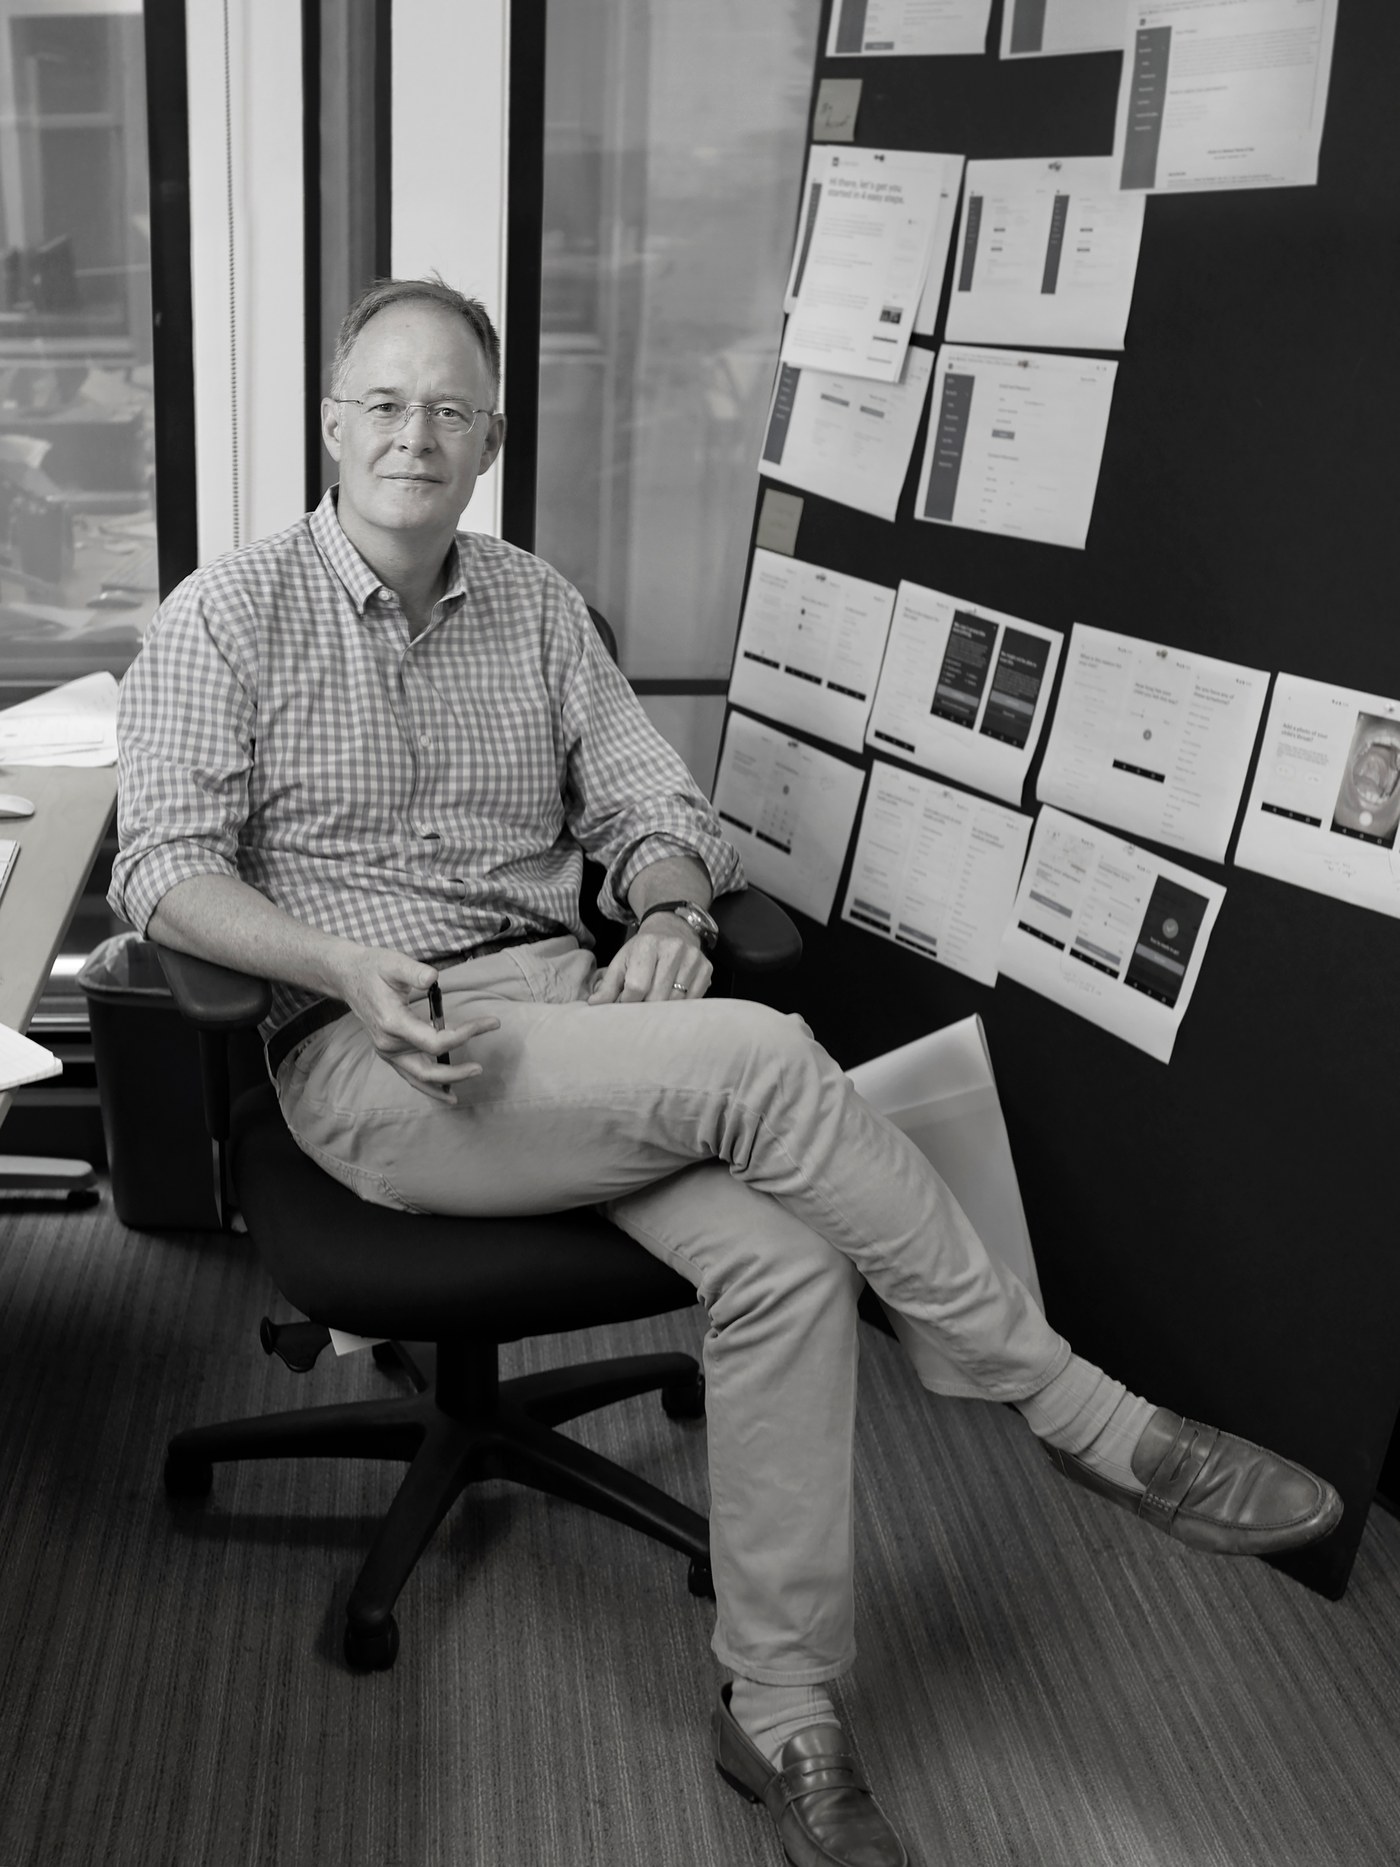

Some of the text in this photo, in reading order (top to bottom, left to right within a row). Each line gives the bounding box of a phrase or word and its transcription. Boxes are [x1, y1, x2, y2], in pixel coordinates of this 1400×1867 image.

[829, 177, 837, 186] Hi
[859, 178, 874, 189] let's
[875, 182, 888, 193] get
[889, 184, 903, 194] you
[827, 189, 852, 199] started
[867, 193, 882, 203] easy
